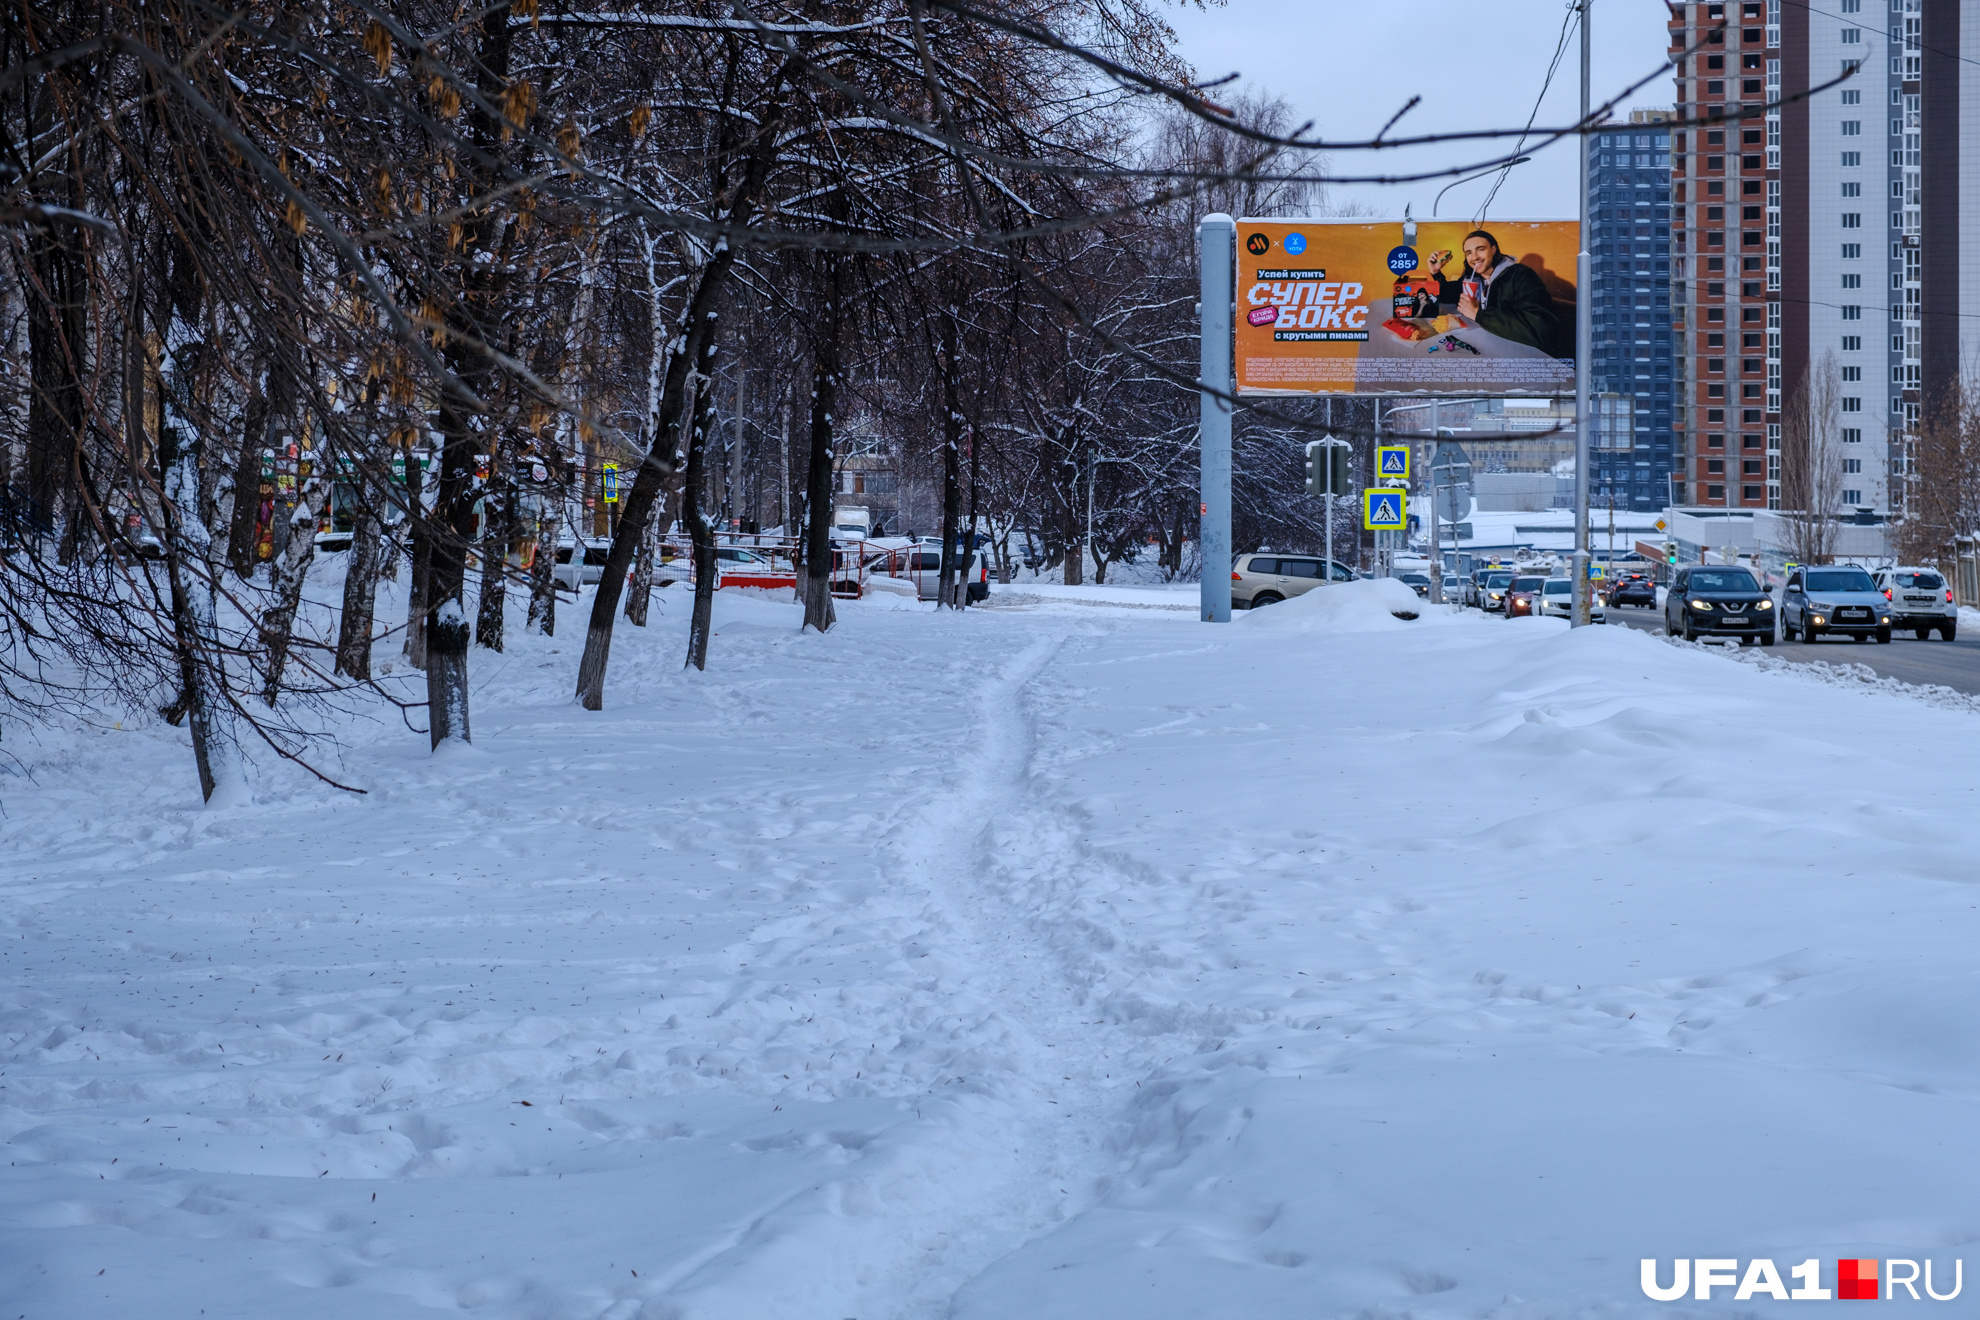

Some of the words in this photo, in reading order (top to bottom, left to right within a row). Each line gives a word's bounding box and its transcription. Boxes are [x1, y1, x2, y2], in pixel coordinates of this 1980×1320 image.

[1258, 269, 1289, 279] Успей
[1290, 270, 1325, 280] купить
[1247, 282, 1364, 305] СУПЕР
[1252, 309, 1273, 318] ЕГОРА
[1274, 305, 1369, 328] БОКС
[1283, 332, 1327, 341] крутыми
